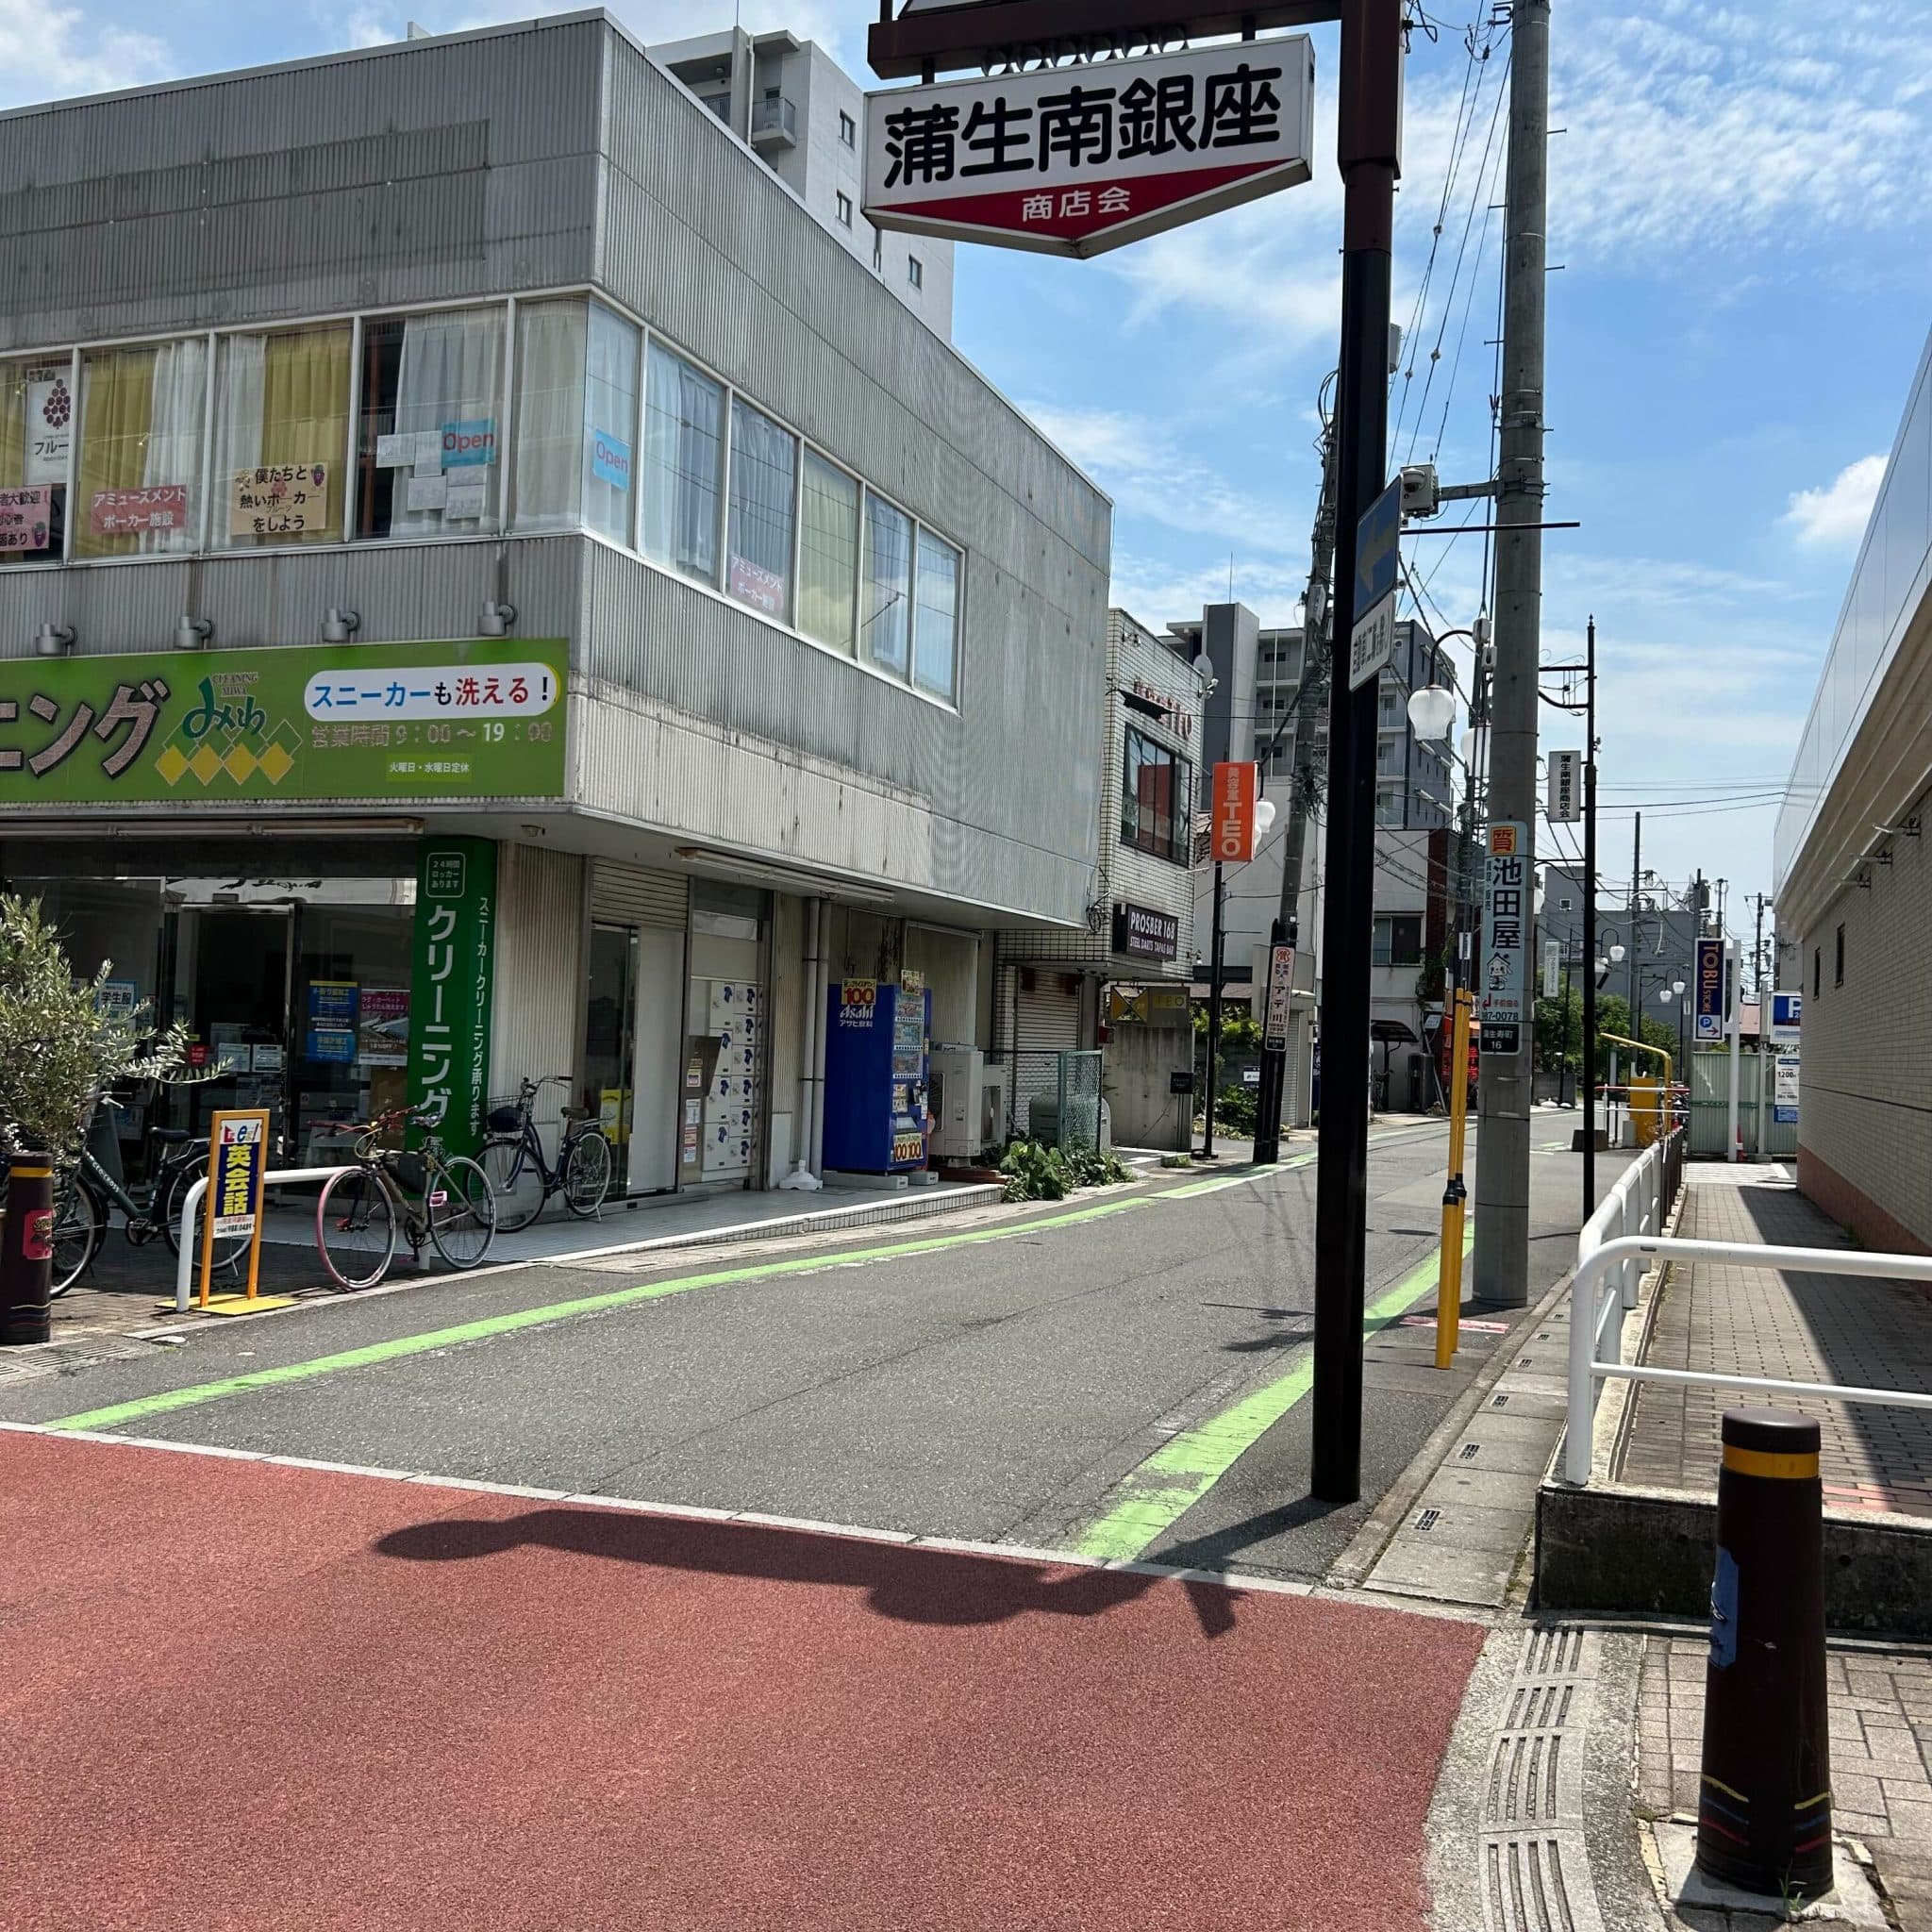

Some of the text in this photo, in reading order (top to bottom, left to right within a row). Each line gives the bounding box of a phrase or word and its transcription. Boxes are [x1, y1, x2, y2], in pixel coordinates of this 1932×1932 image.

[884, 63, 1283, 188] 蒲生南銀座
[1022, 186, 1131, 222] 商店会
[442, 433, 494, 453] Open
[596, 441, 628, 473] Open
[255, 465, 307, 484] 僕たちと
[93, 487, 186, 508] アミューズメント
[103, 511, 175, 529] ポーカー施設
[253, 514, 305, 532] をしよう
[211, 672, 258, 685] CLEANING
[312, 676, 548, 708] スニーカーも洗える！
[311, 724, 390, 748] 営業時間
[389, 761, 470, 774] 火曜日・水曜日定休
[1559, 755, 1571, 818] 蒲生南銀座商店会
[1221, 802, 1242, 857] TEO
[1491, 857, 1522, 949] 池田屋
[1130, 911, 1175, 940] PROSBER 168
[1703, 943, 1718, 989] TOBU
[101, 991, 132, 1005] 学生服
[843, 987, 874, 1006] 100
[420, 905, 457, 1120] クリーニング
[469, 896, 490, 1137] スニーカークリーニング承ります
[840, 1005, 874, 1019] Asahi
[223, 1143, 252, 1216] 英会話
